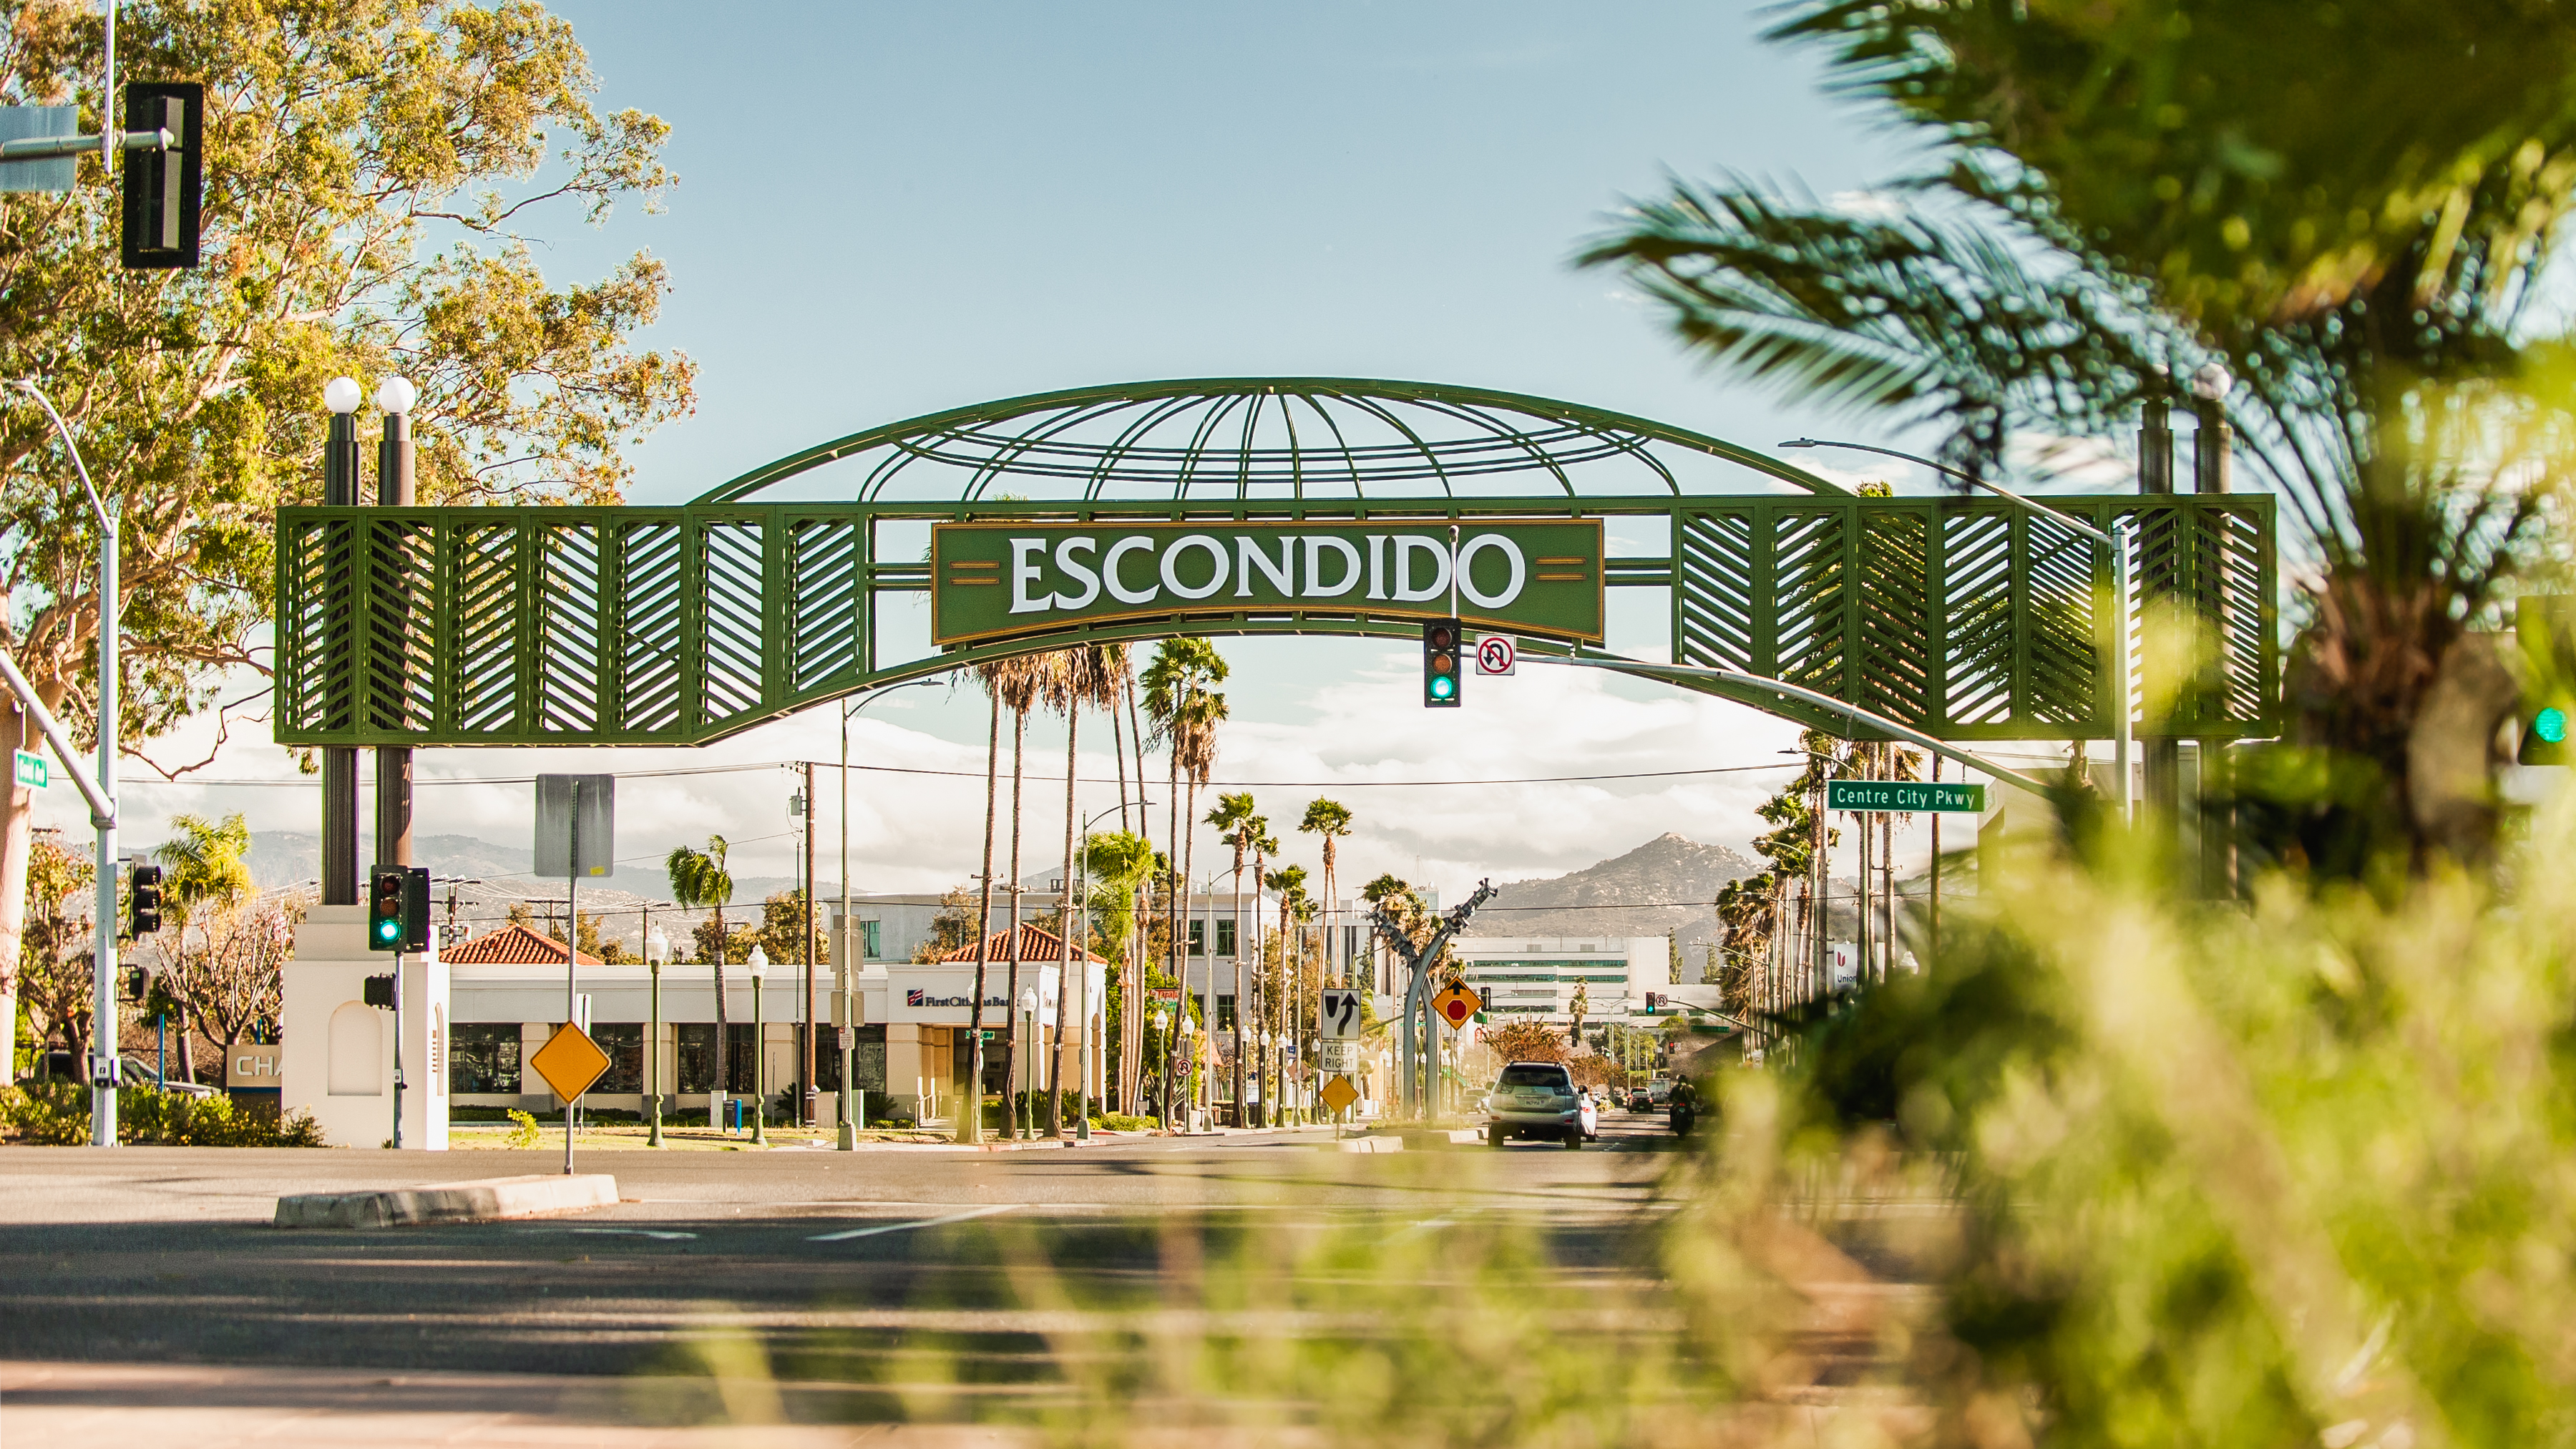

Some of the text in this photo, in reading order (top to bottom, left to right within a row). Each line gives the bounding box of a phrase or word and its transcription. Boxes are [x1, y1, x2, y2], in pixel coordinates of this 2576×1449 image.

[1009, 533, 1526, 613] ESCONDIDO
[1837, 787, 1889, 804] Centre
[1897, 789, 1928, 809] City
[1936, 789, 1975, 810] Pkwy
[1327, 1045, 1353, 1055] KEEP
[1324, 1058, 1354, 1068] RIGHT
